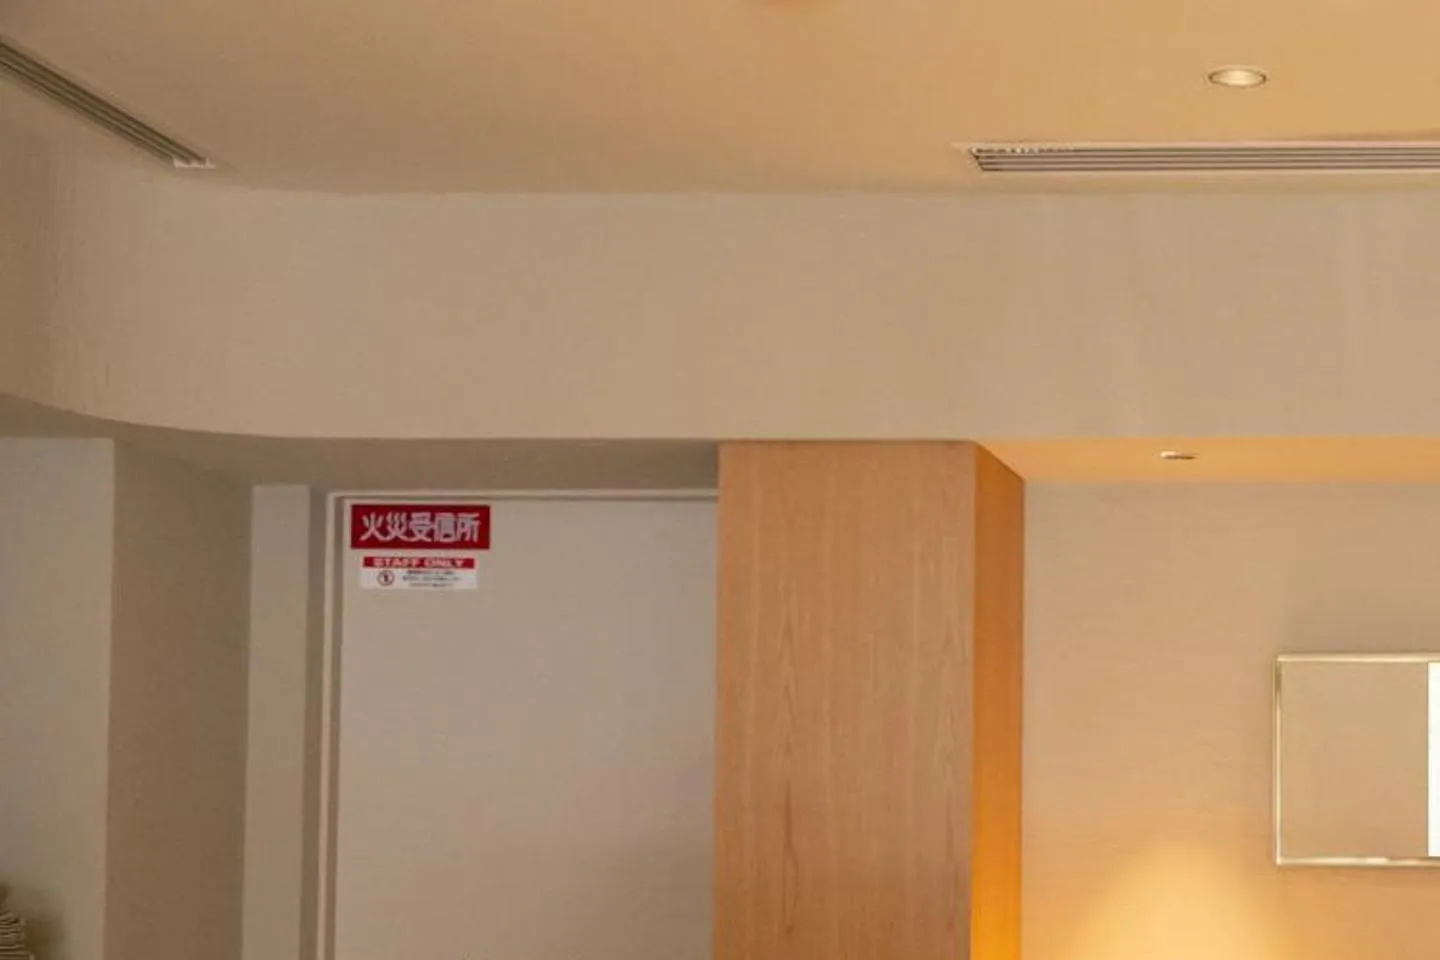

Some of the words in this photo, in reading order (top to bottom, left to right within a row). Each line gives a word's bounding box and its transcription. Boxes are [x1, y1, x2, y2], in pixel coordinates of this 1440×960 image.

[359, 511, 482, 543] 火災受信所
[373, 557, 420, 568] STAFF
[424, 558, 465, 569] ONLY
